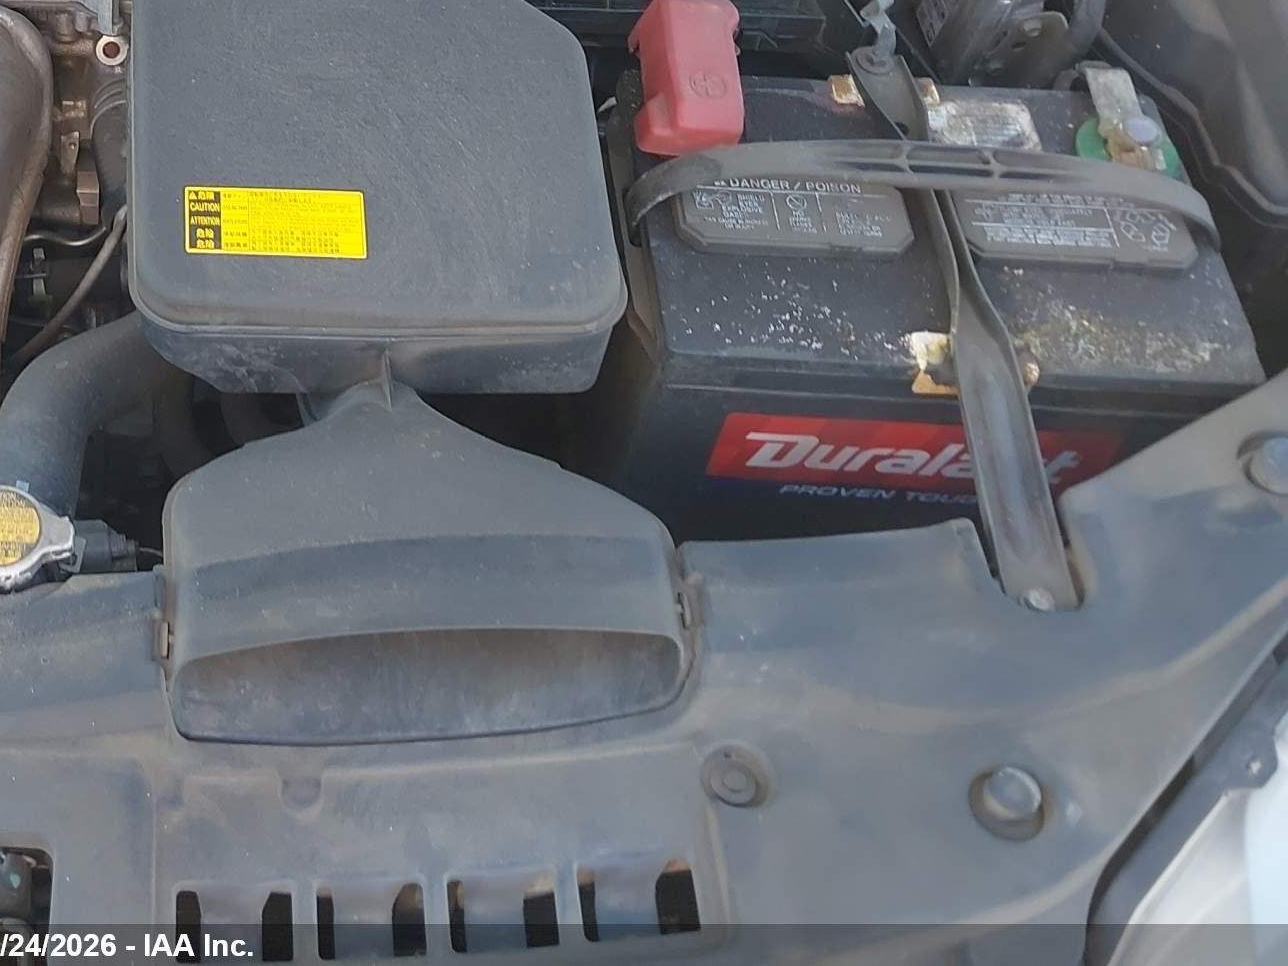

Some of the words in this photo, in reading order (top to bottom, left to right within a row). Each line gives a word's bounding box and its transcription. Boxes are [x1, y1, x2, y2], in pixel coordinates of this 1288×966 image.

[729, 177, 791, 190] DANGER
[190, 202, 220, 212] CAUTION
[190, 216, 220, 227] ATTENTION
[745, 432, 1079, 484] Duralat
[778, 484, 897, 499] PROVEN
